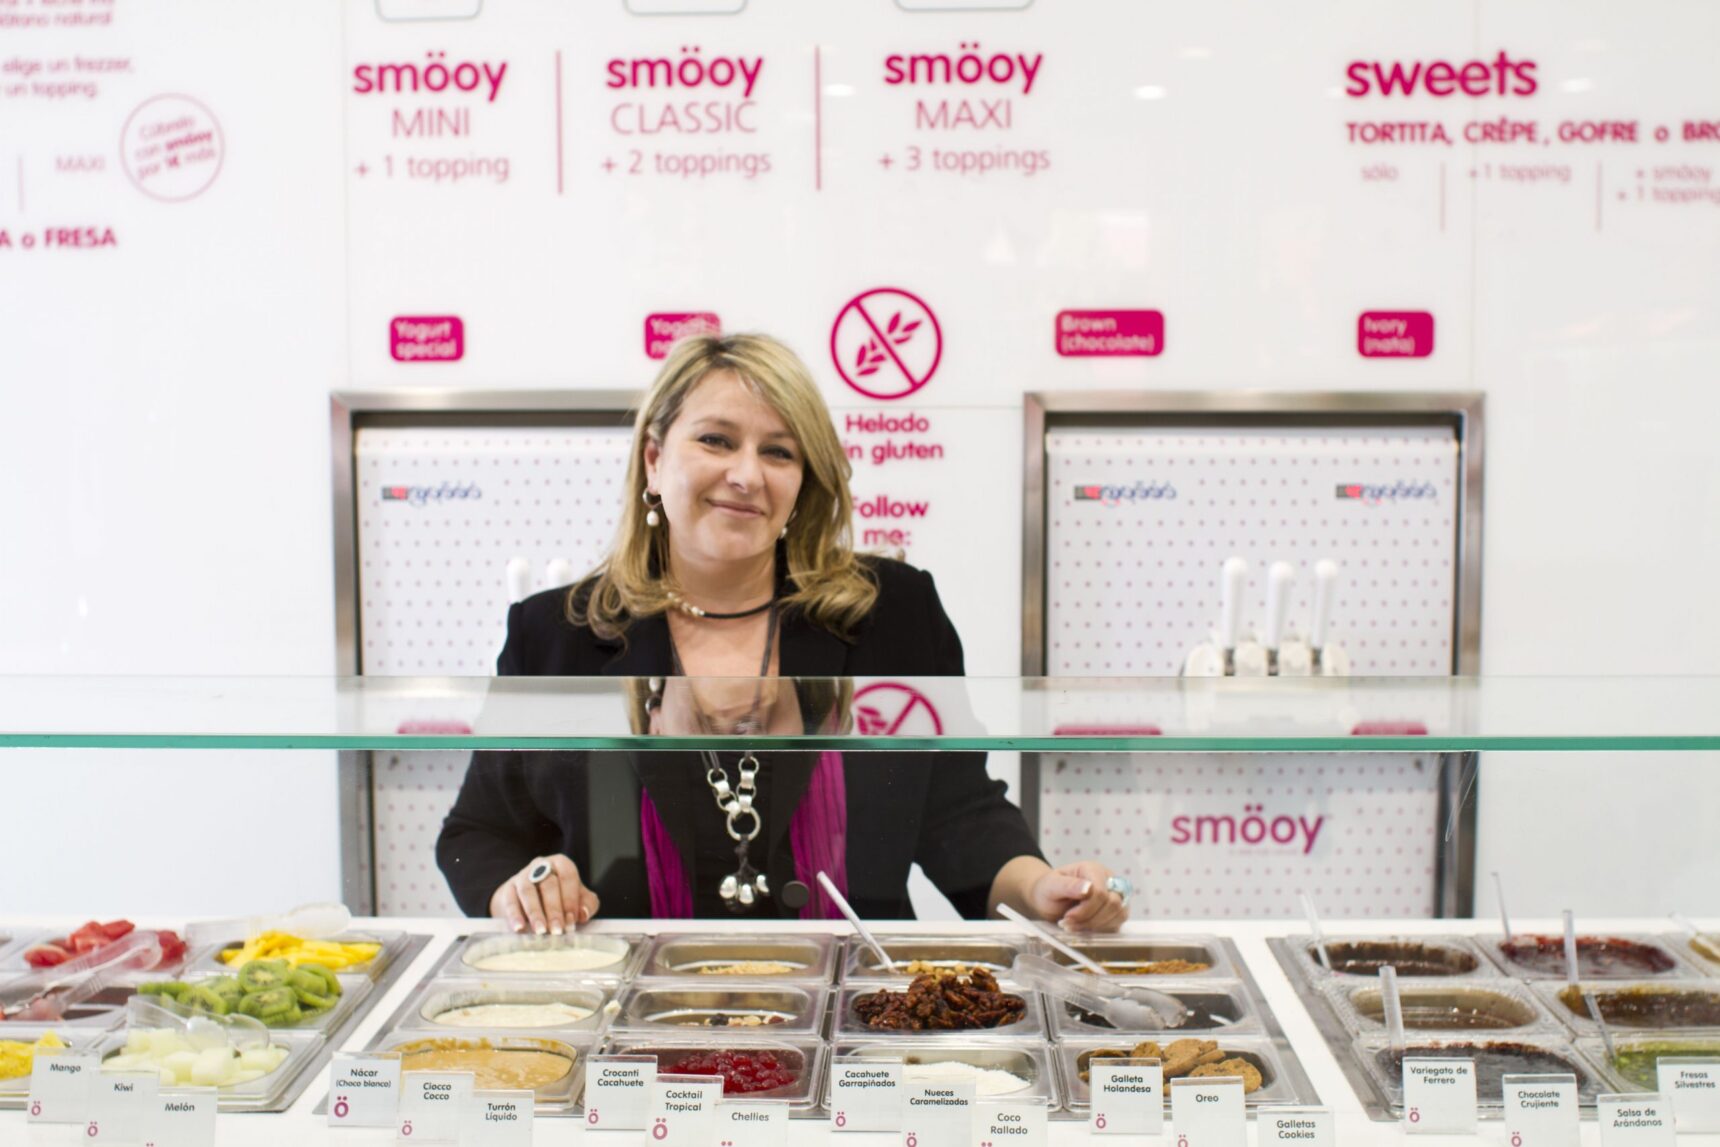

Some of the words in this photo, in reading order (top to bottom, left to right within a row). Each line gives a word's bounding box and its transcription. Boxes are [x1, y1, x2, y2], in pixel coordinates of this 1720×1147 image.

[606, 46, 764, 98] smöoy
[884, 42, 1043, 95] smöoy
[1345, 50, 1538, 98] sweets
[353, 50, 508, 102] smöoy
[610, 101, 757, 135] CLASSIC
[915, 99, 1013, 130] MAXI
[391, 107, 471, 138] MINI
[1558, 121, 1639, 143] GOFRE
[1655, 126, 1670, 142] o
[628, 150, 644, 175] 2
[655, 147, 772, 179] toppings
[906, 146, 922, 171] 3
[932, 144, 1051, 176] toppings
[384, 153, 394, 177] 1
[406, 151, 511, 183] topping
[1499, 162, 1572, 184] topping
[44, 227, 117, 248] FRESA
[1061, 315, 1117, 332] Brown
[1363, 316, 1407, 336] Ivory
[396, 320, 451, 341] Yogurt
[845, 413, 930, 433] Helado
[842, 440, 863, 459] in
[871, 439, 944, 465] gluten
[1170, 803, 1325, 855] smöoy
[50, 1063, 81, 1074] Mango
[350, 1068, 378, 1078] Nácar
[602, 1068, 639, 1078] Crocanti
[1410, 1065, 1453, 1078] Variegato
[1456, 1065, 1468, 1075] de
[845, 1070, 890, 1079] Cacahuete
[1111, 1074, 1143, 1084] Galleta
[1680, 1071, 1708, 1079] Fresas
[336, 1079, 361, 1088] (Choco
[363, 1079, 392, 1088] blanco)
[423, 1081, 452, 1091] Ciocco
[597, 1077, 645, 1088] Cacahuete
[838, 1078, 896, 1089] Garrapiñados
[1423, 1076, 1456, 1085] Ferrero
[1674, 1080, 1716, 1089] Silvestres
[114, 1083, 134, 1093] Kiwi
[924, 1088, 954, 1097] Nueces
[1103, 1083, 1152, 1094] Holandesa
[423, 1092, 450, 1101] Cocco
[665, 1090, 703, 1100] Cocktail
[1195, 1093, 1219, 1103] Oreo
[1517, 1089, 1560, 1099] Chocolate
[164, 1101, 196, 1113] Melón
[487, 1102, 516, 1112] Turrón
[665, 1102, 702, 1113] Tropical
[909, 1097, 969, 1107] Caramelizadas
[1520, 1099, 1560, 1110] Crujiente
[485, 1111, 518, 1122] Líquido
[731, 1111, 770, 1122] Chellies
[997, 1112, 1021, 1122] Coco
[1616, 1108, 1642, 1118] Salsa
[1644, 1108, 1657, 1117] de
[1276, 1119, 1316, 1130] Galletas
[1613, 1117, 1663, 1128] Arándanos
[990, 1125, 1029, 1136] Rallado
[1278, 1130, 1316, 1140] Cookies
